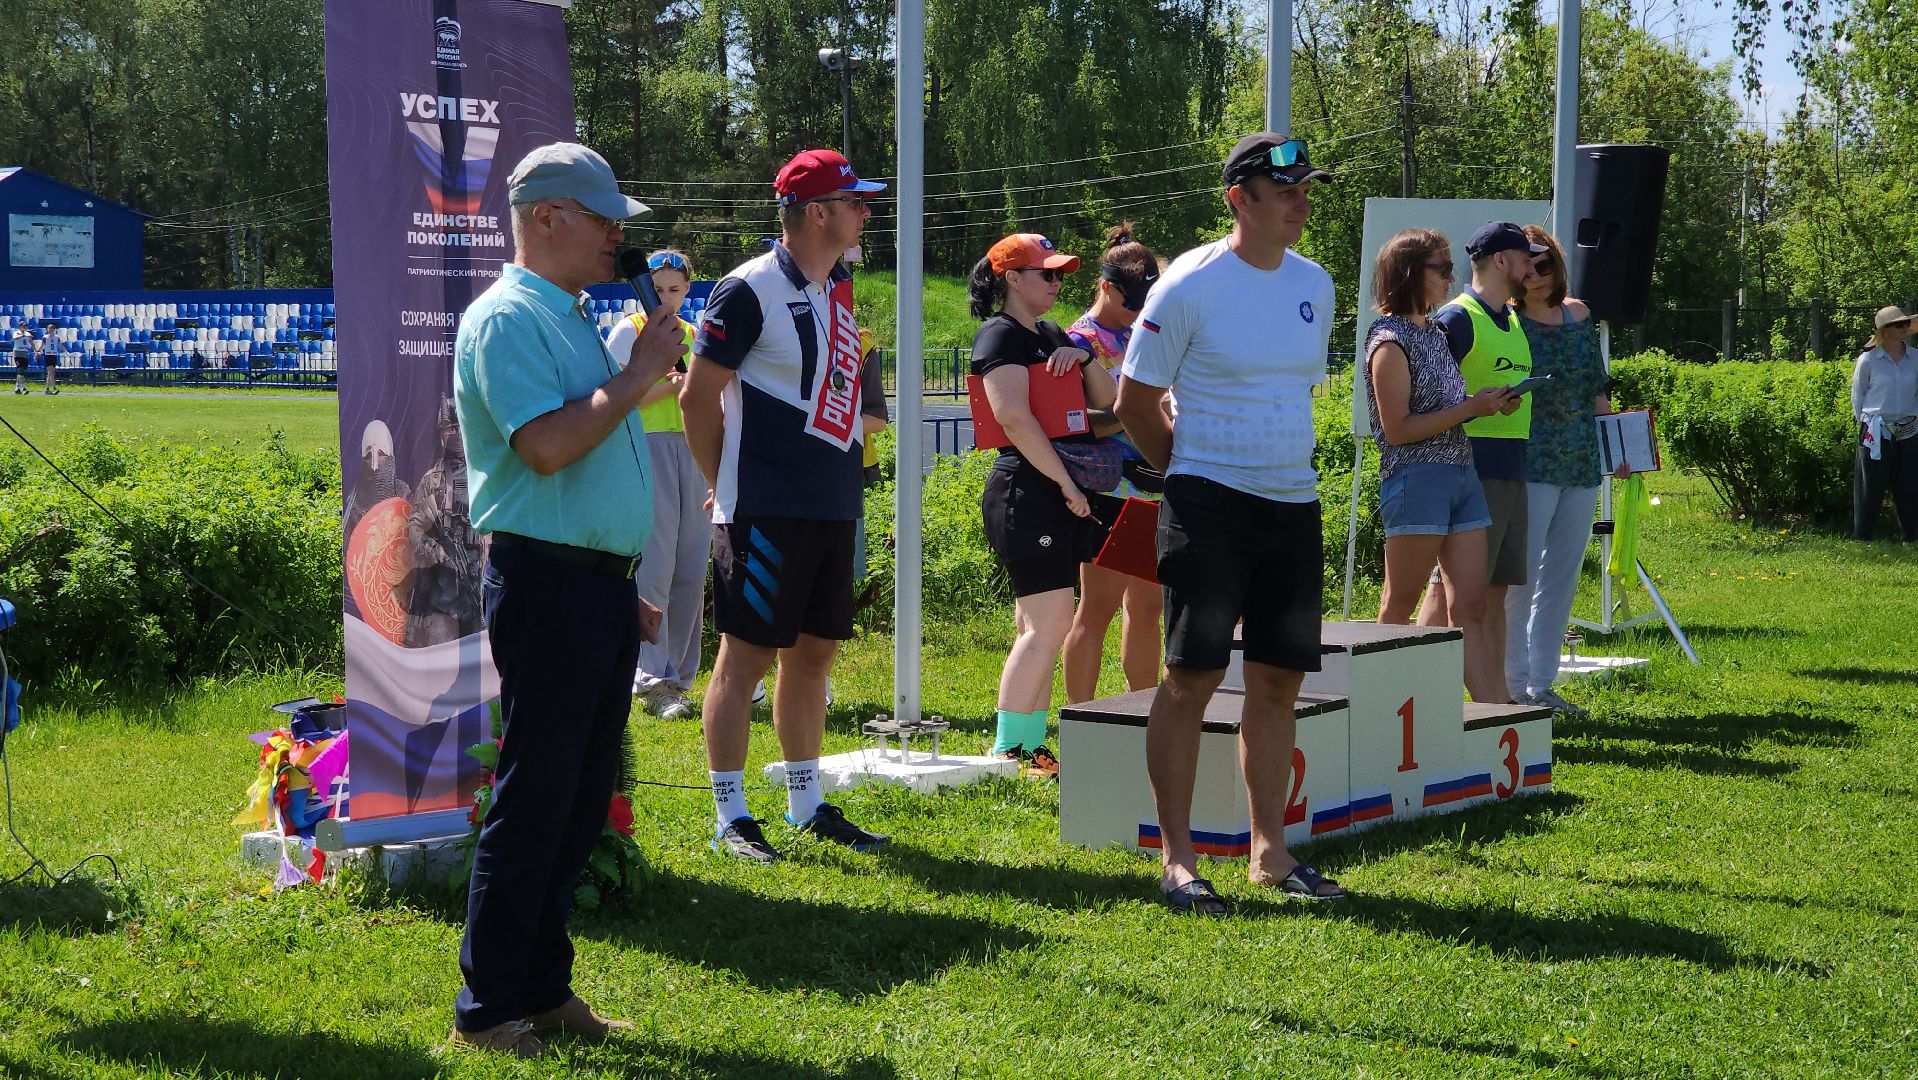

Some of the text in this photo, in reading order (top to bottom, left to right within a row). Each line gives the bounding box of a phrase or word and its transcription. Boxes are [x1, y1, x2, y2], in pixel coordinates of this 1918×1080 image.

[436, 46, 460, 55] ЕДИНАЯ
[436, 53, 460, 61] РОССИЯ
[400, 92, 501, 124] УСПЕХ
[413, 212, 498, 229] ЕДИНСТВЕ
[407, 231, 505, 247] ПОКОЛЕНИЙ
[407, 267, 477, 278] ПАТРИОТИЧЕСКИЙ
[401, 310, 455, 327] СОХРАНЯЯ
[398, 339, 457, 358] ЗАЩИЩАЕ
[1397, 696, 1419, 772] 1
[1496, 727, 1520, 798] 3
[1283, 747, 1308, 826] 2
